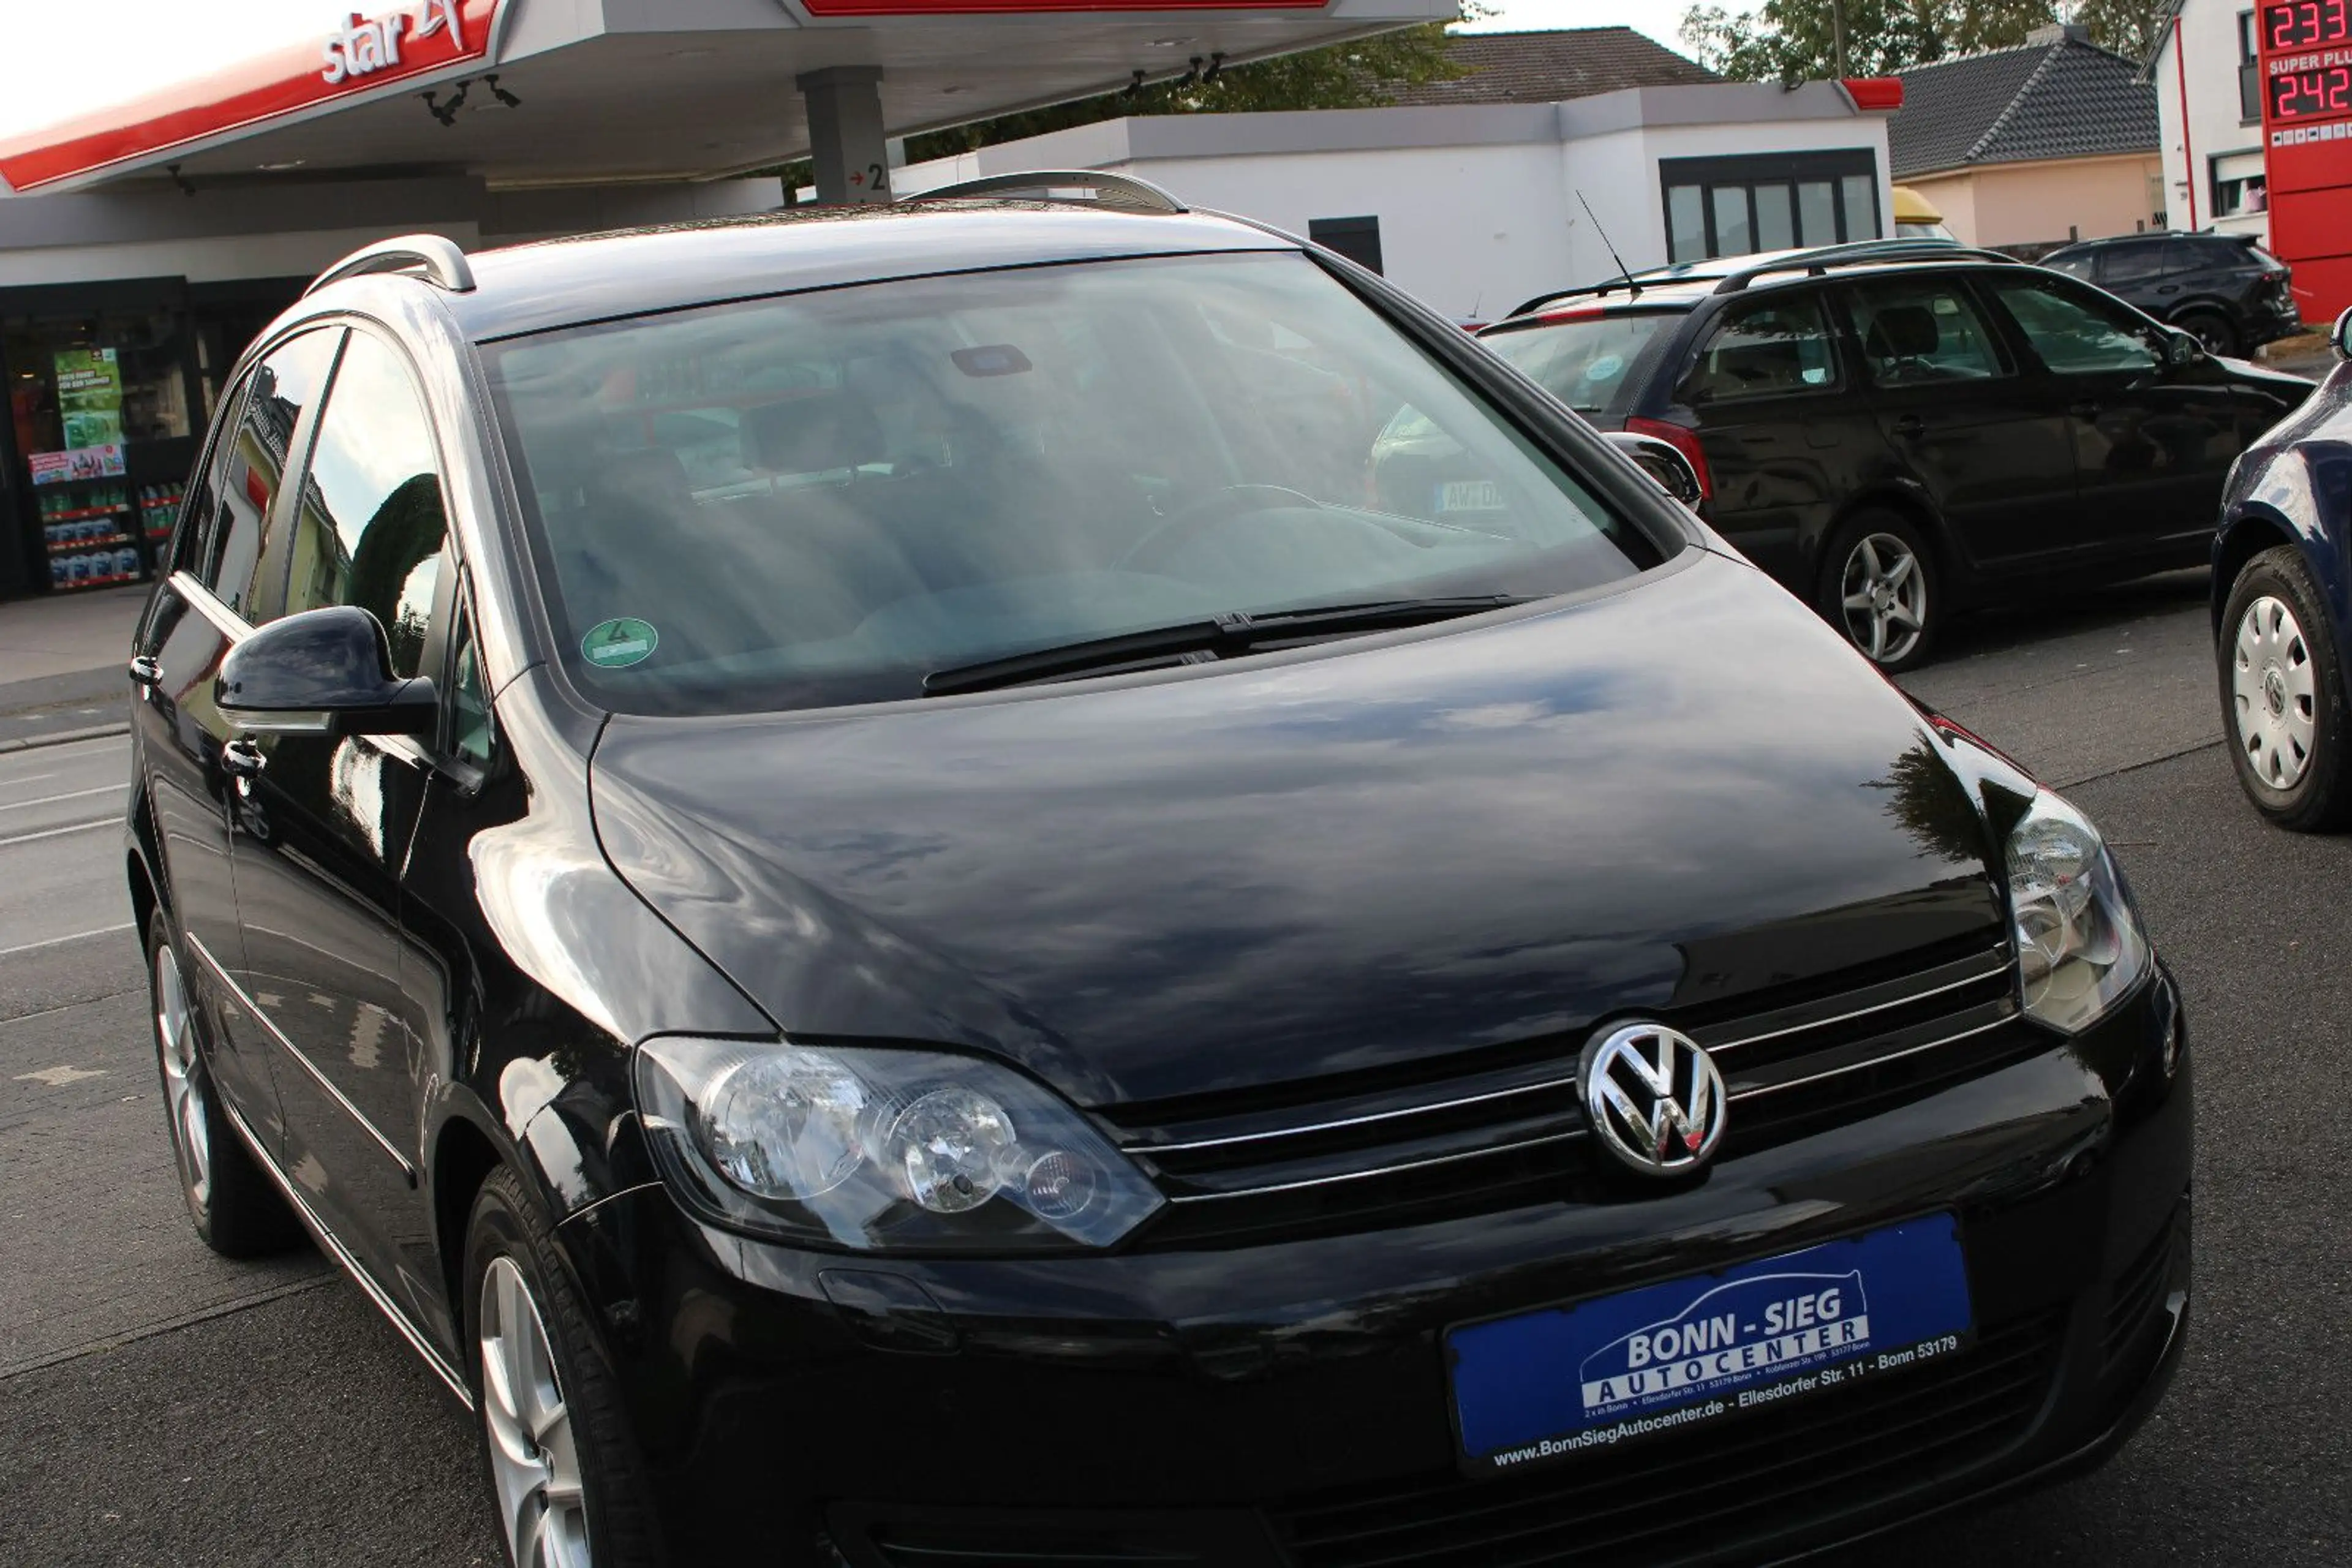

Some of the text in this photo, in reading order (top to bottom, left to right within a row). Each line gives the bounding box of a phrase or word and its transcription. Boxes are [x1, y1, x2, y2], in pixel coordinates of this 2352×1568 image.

[322, 12, 403, 84] star
[2274, 0, 2346, 47] 233
[2269, 55, 2320, 75] SUPER
[2278, 69, 2348, 116] 242
[869, 163, 886, 190] 2
[1598, 1321, 1856, 1403] AUTOCENTER
[1627, 1313, 1736, 1368] BONN
[1763, 1287, 1841, 1336] SIEG
[1493, 1400, 1724, 1467] www.BonnSiegAutocenter.de
[1738, 1376, 1816, 1408] Ellesdorfer
[1821, 1368, 1844, 1386] Str.
[1849, 1361, 1864, 1378] 11
[1877, 1351, 1915, 1370] Bonn
[1917, 1335, 1958, 1359] 53179
[1606, 1402, 1628, 1413] Bonn
[1642, 1390, 1682, 1405] Ellesdorfer
[1733, 1372, 1752, 1382] Bonn
[1852, 1341, 1871, 1351] Bonn
